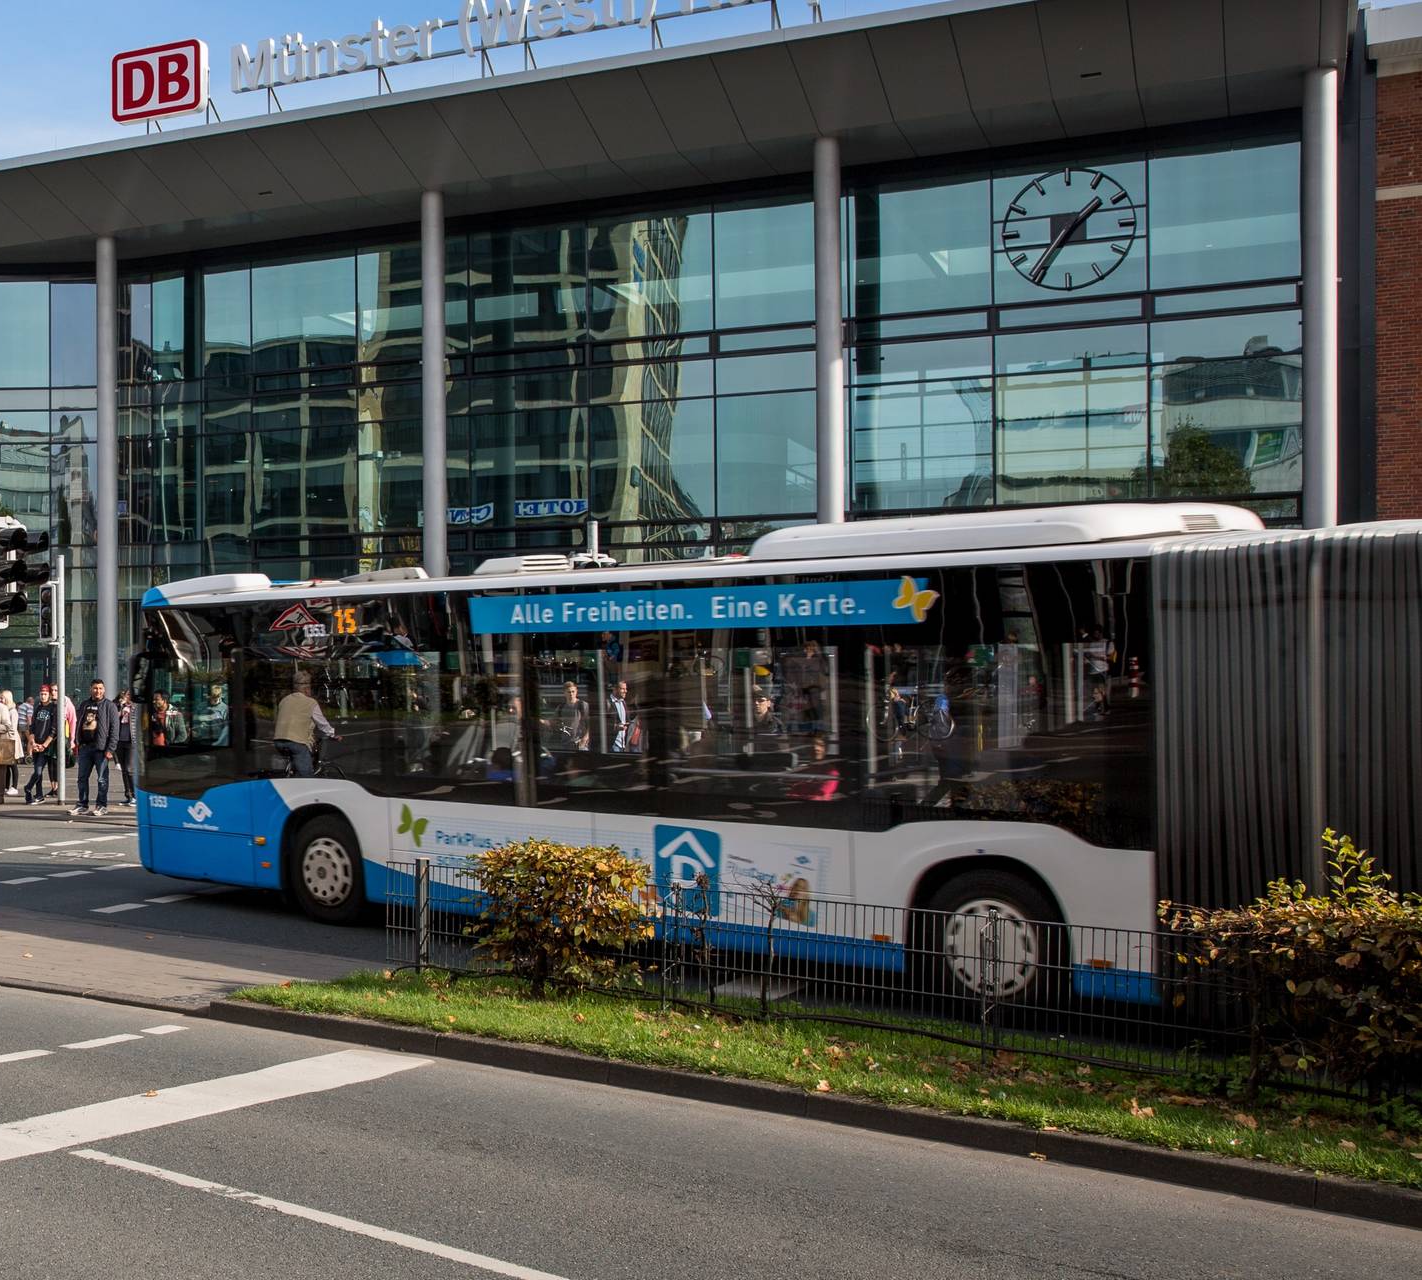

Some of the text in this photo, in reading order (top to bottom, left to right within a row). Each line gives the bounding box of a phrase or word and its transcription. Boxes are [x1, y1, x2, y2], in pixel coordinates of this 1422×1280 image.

[231, 16, 444, 93] Münster
[122, 53, 190, 111] DB
[333, 608, 357, 635] 15
[510, 593, 867, 625] Alle Freiheiten. Eine Karte.
[303, 623, 327, 638] 1353
[149, 795, 168, 808] 1353
[435, 829, 492, 849] ParkPlus
